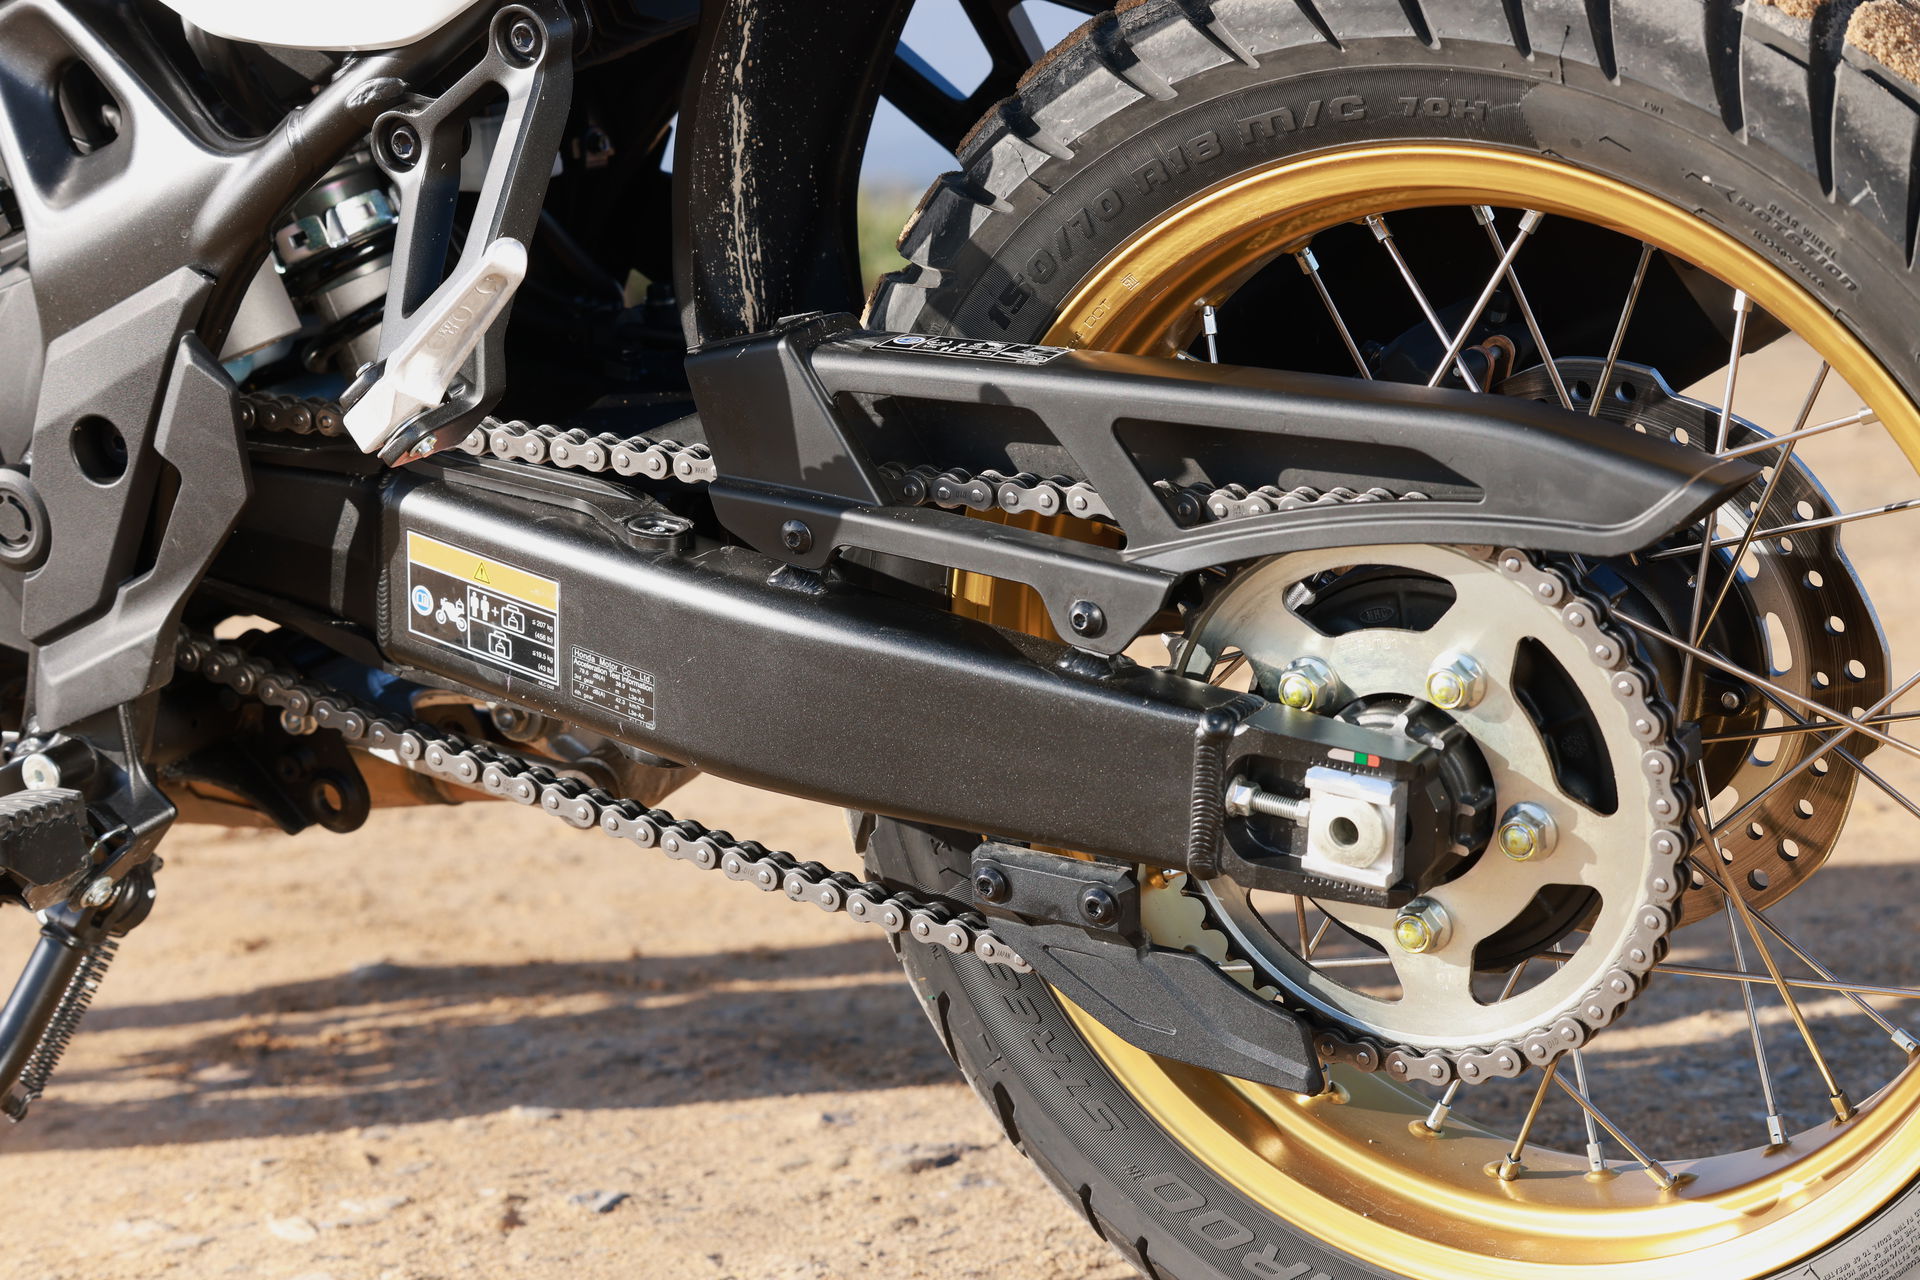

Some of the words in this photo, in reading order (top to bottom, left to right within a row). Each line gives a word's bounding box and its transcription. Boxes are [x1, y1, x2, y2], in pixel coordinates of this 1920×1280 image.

[988, 187, 1123, 330] 150/70
[1131, 130, 1223, 196] R18
[1399, 96, 1488, 122] 70H
[1767, 202, 1799, 229] REAR
[1803, 227, 1837, 258] WHEEL
[1736, 196, 1857, 291] ROTATION
[1084, 298, 1110, 328] DOT
[574, 648, 595, 664] Honda
[599, 657, 618, 671] Motor
[639, 672, 652, 684] Ltd.
[574, 658, 608, 675] Acceleration
[609, 670, 620, 681] Test
[621, 674, 653, 692] Information
[629, 686, 642, 695] km/h
[629, 702, 642, 711] km/h
[983, 960, 1129, 1132] STREE
